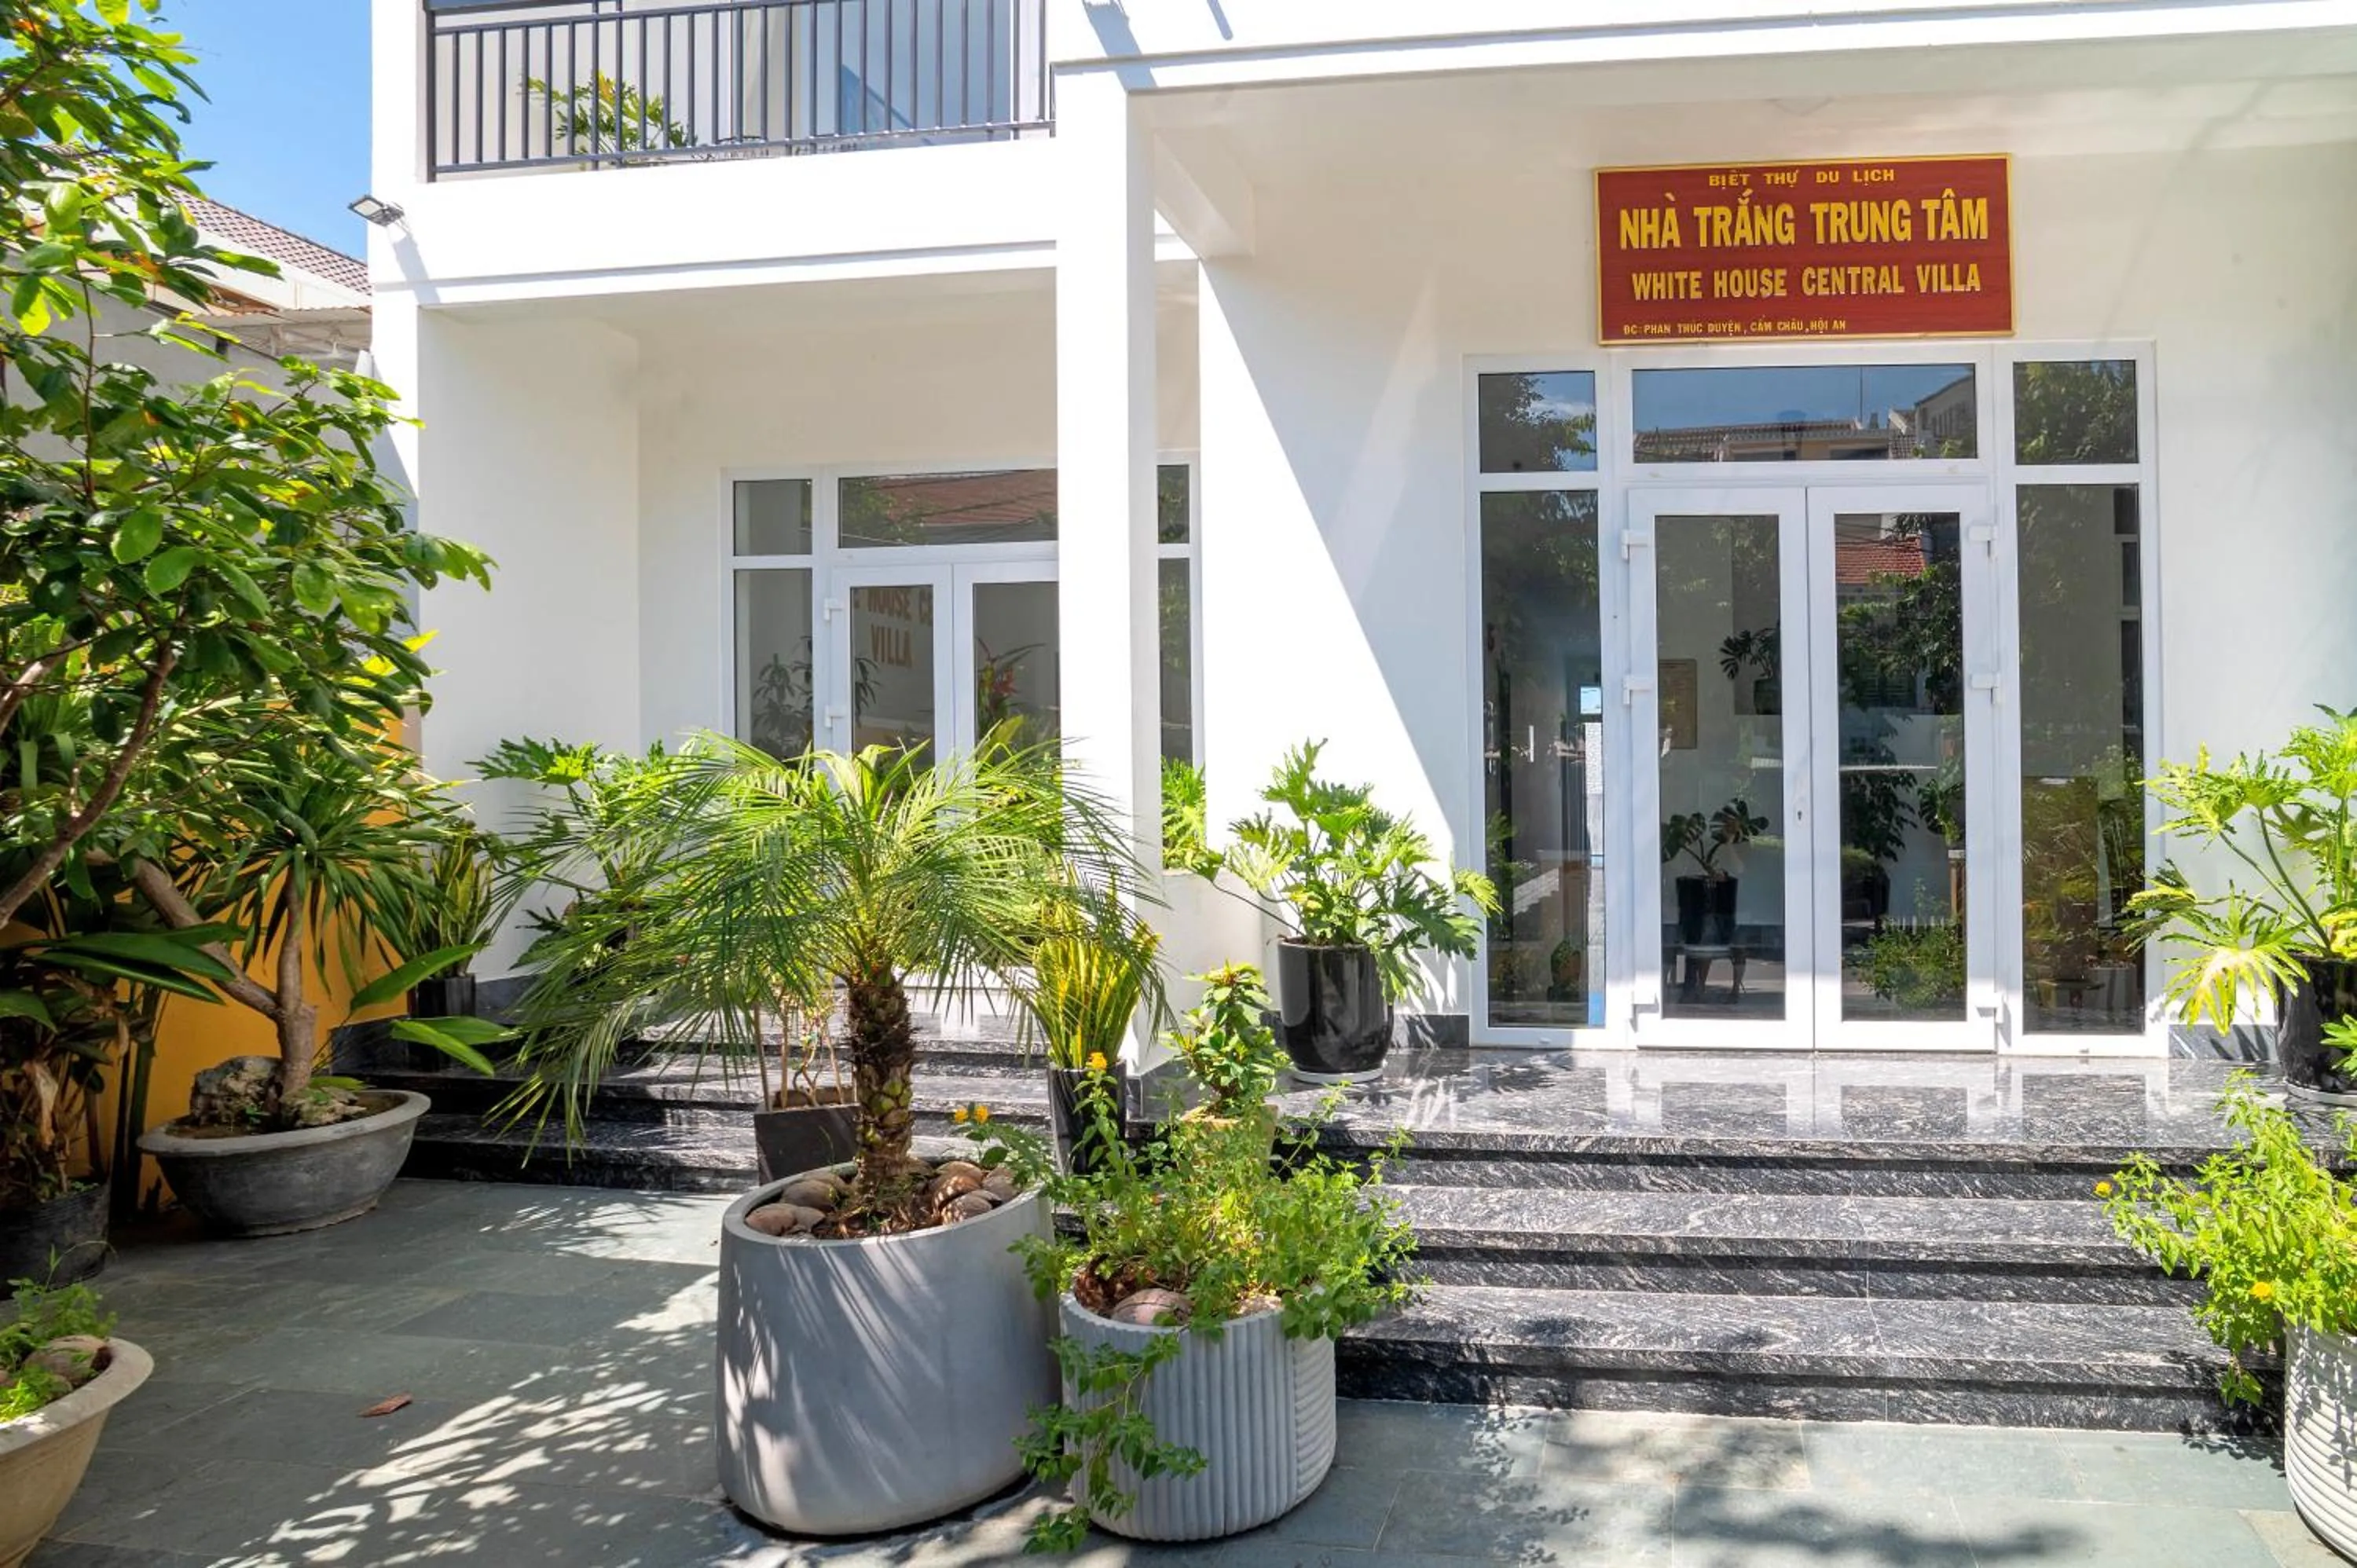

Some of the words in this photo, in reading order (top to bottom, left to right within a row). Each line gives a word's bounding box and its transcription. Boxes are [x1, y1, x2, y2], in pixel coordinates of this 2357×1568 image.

[1816, 170, 1839, 183] DU
[1853, 169, 1895, 186] LỊCH
[1620, 192, 1682, 250] NHÀ
[1692, 188, 1795, 248] TRẮNG
[1809, 199, 1912, 244] TRUNG
[1921, 188, 1989, 241] TÂM
[1632, 271, 1703, 302] WHITE
[1714, 268, 1788, 299] HOUSE
[1802, 266, 1906, 296] CENTRAL
[1915, 263, 1981, 294] VILLA
[1644, 322, 1671, 335] PHAN
[871, 624, 912, 668] VILLA
